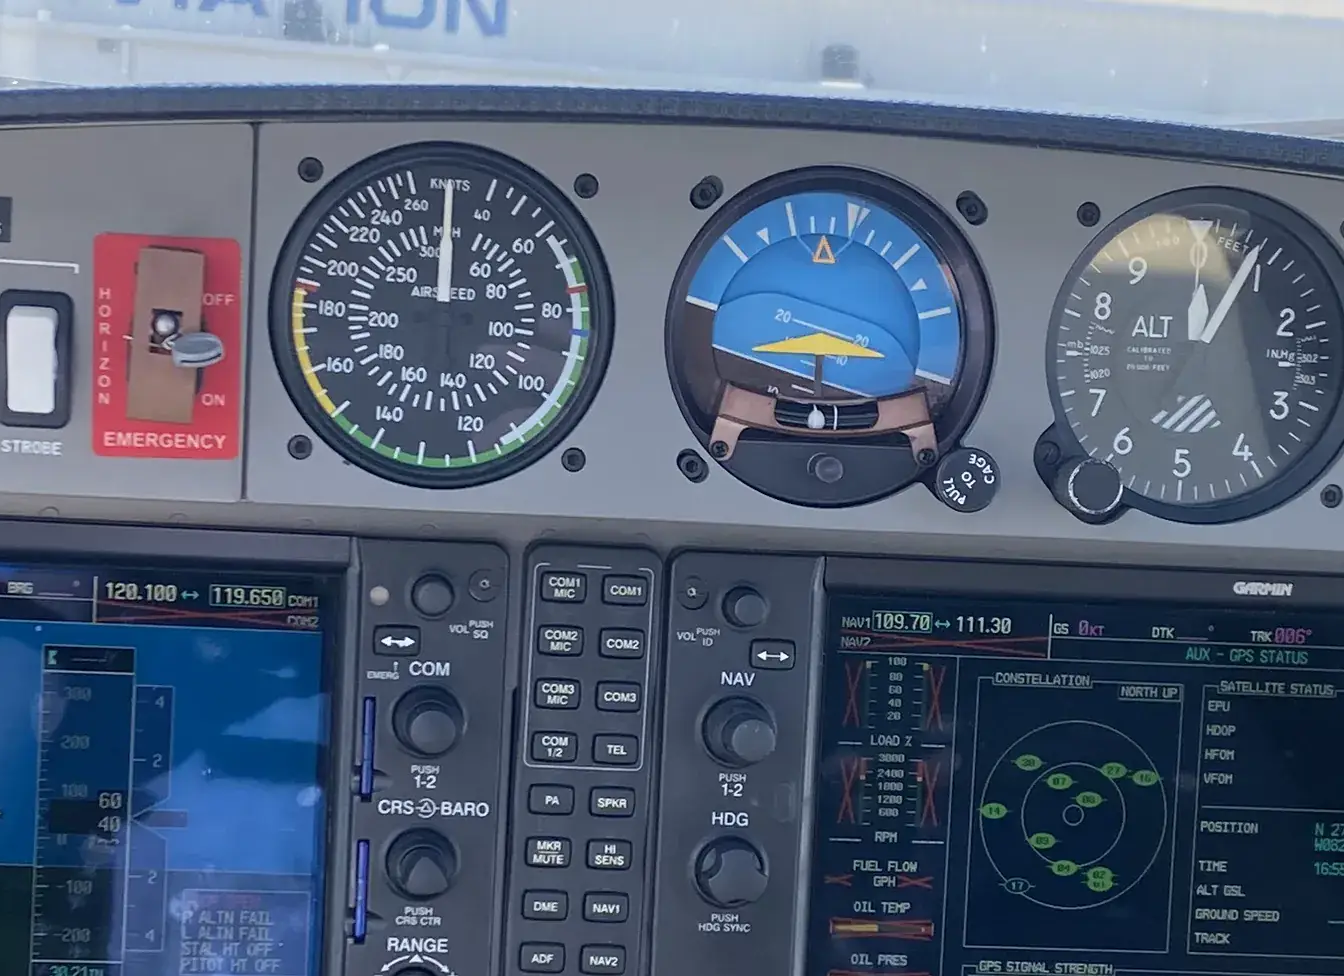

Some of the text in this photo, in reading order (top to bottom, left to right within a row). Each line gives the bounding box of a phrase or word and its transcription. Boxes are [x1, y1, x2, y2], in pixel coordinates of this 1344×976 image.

[403, 198, 429, 212] 260
[370, 208, 403, 226] 240
[348, 225, 381, 244] 220
[327, 259, 359, 278] 200
[1127, 255, 1148, 285] 9
[318, 299, 346, 318] 180
[541, 302, 562, 319] 80
[1131, 315, 1173, 338] ALT
[1276, 307, 1296, 337] 2
[326, 356, 354, 374] 160
[1269, 391, 1289, 420] 3
[0, 439, 63, 456] STROBE
[103, 431, 227, 450] EMERGENCY
[1113, 426, 1133, 455] 6
[1172, 448, 1192, 478] 5
[609, 584, 642, 596] COM1
[875, 613, 1012, 634] 109.70 111.30
[1185, 646, 1309, 665] AUX GPS STATUS
[408, 660, 451, 677] COM
[606, 744, 627, 755] TEL
[597, 797, 627, 809] SPKR
[711, 811, 749, 827] HDG
[1200, 820, 1259, 834] POSITION
[592, 903, 620, 914] NAV1
[1195, 908, 1280, 922] GROUND SPEED
[386, 937, 449, 953] RANGE
[1193, 931, 1231, 945] TRACK
